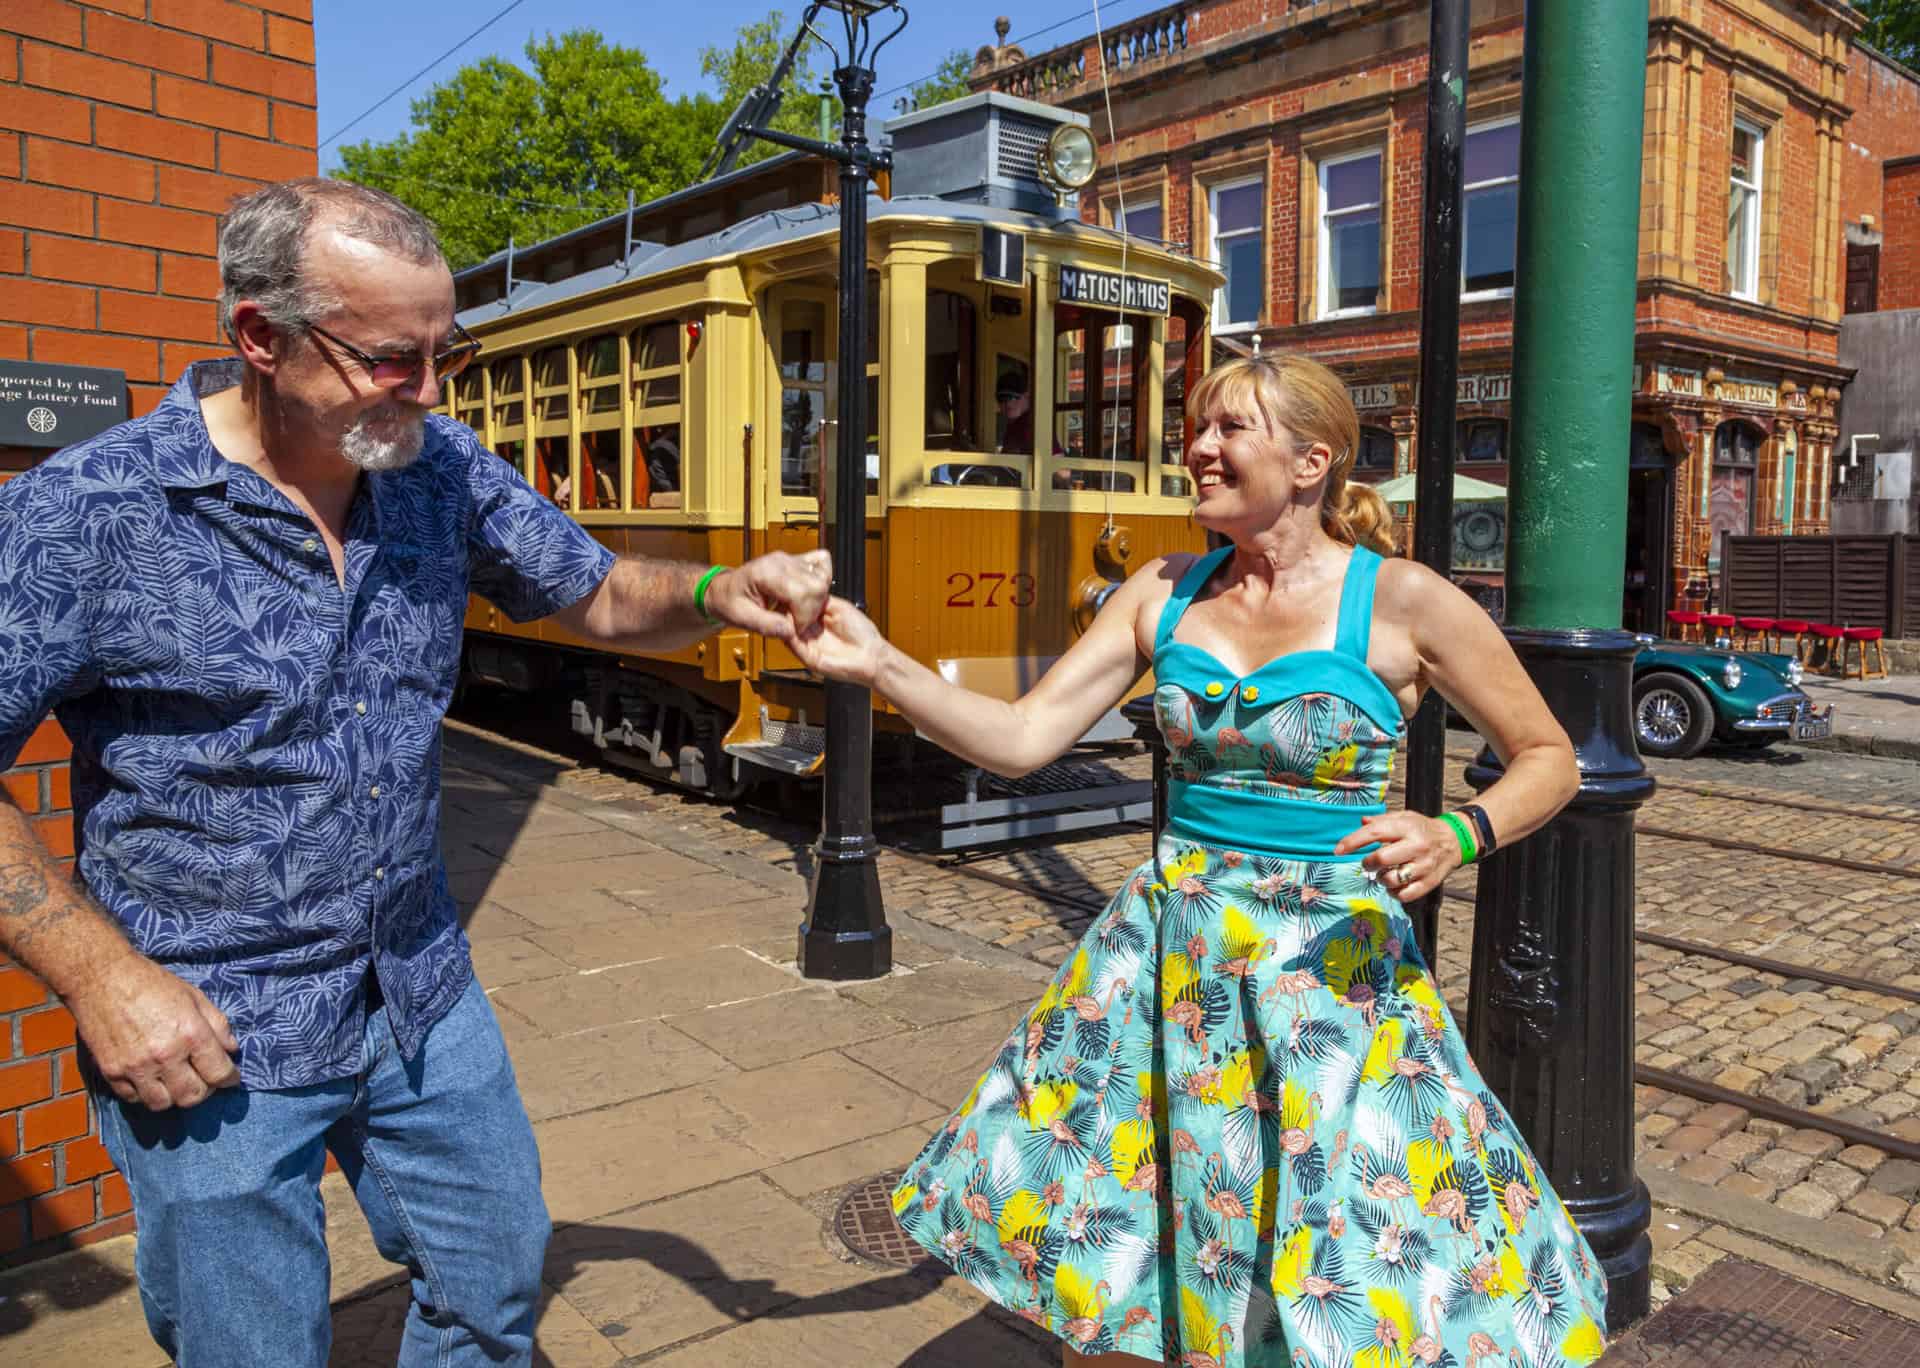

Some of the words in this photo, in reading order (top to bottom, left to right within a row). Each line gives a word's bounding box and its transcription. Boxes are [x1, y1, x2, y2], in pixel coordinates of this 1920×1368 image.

[1062, 269, 1168, 310] MATOSINHOS
[57, 378, 72, 392] by
[78, 380, 99, 392] the
[28, 390, 78, 405] Lottery
[84, 394, 117, 407] Fund
[946, 572, 1035, 608] 273
